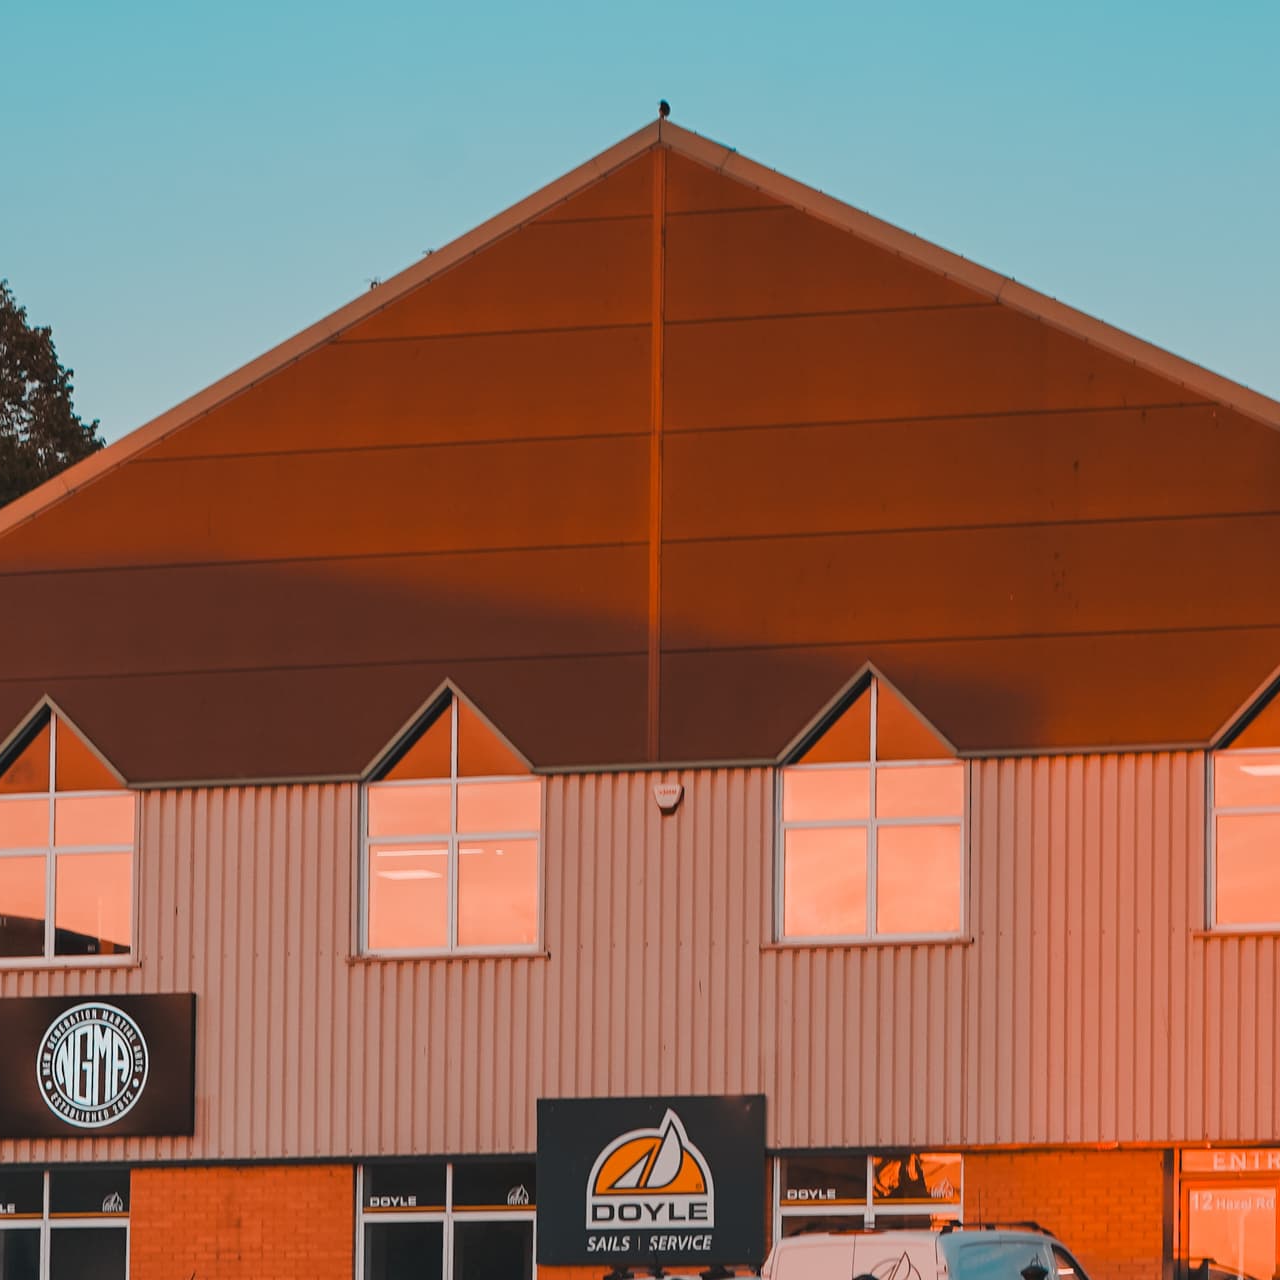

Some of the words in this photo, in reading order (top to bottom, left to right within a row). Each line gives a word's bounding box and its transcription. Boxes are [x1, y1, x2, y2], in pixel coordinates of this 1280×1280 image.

[56, 1024, 130, 1106] NGMA
[369, 1195, 417, 1207] DOYLE
[786, 1188, 836, 1201] DOYLE
[592, 1203, 708, 1222] DOYLE
[587, 1236, 631, 1252] SAILS
[649, 1235, 713, 1251] SERVICE
